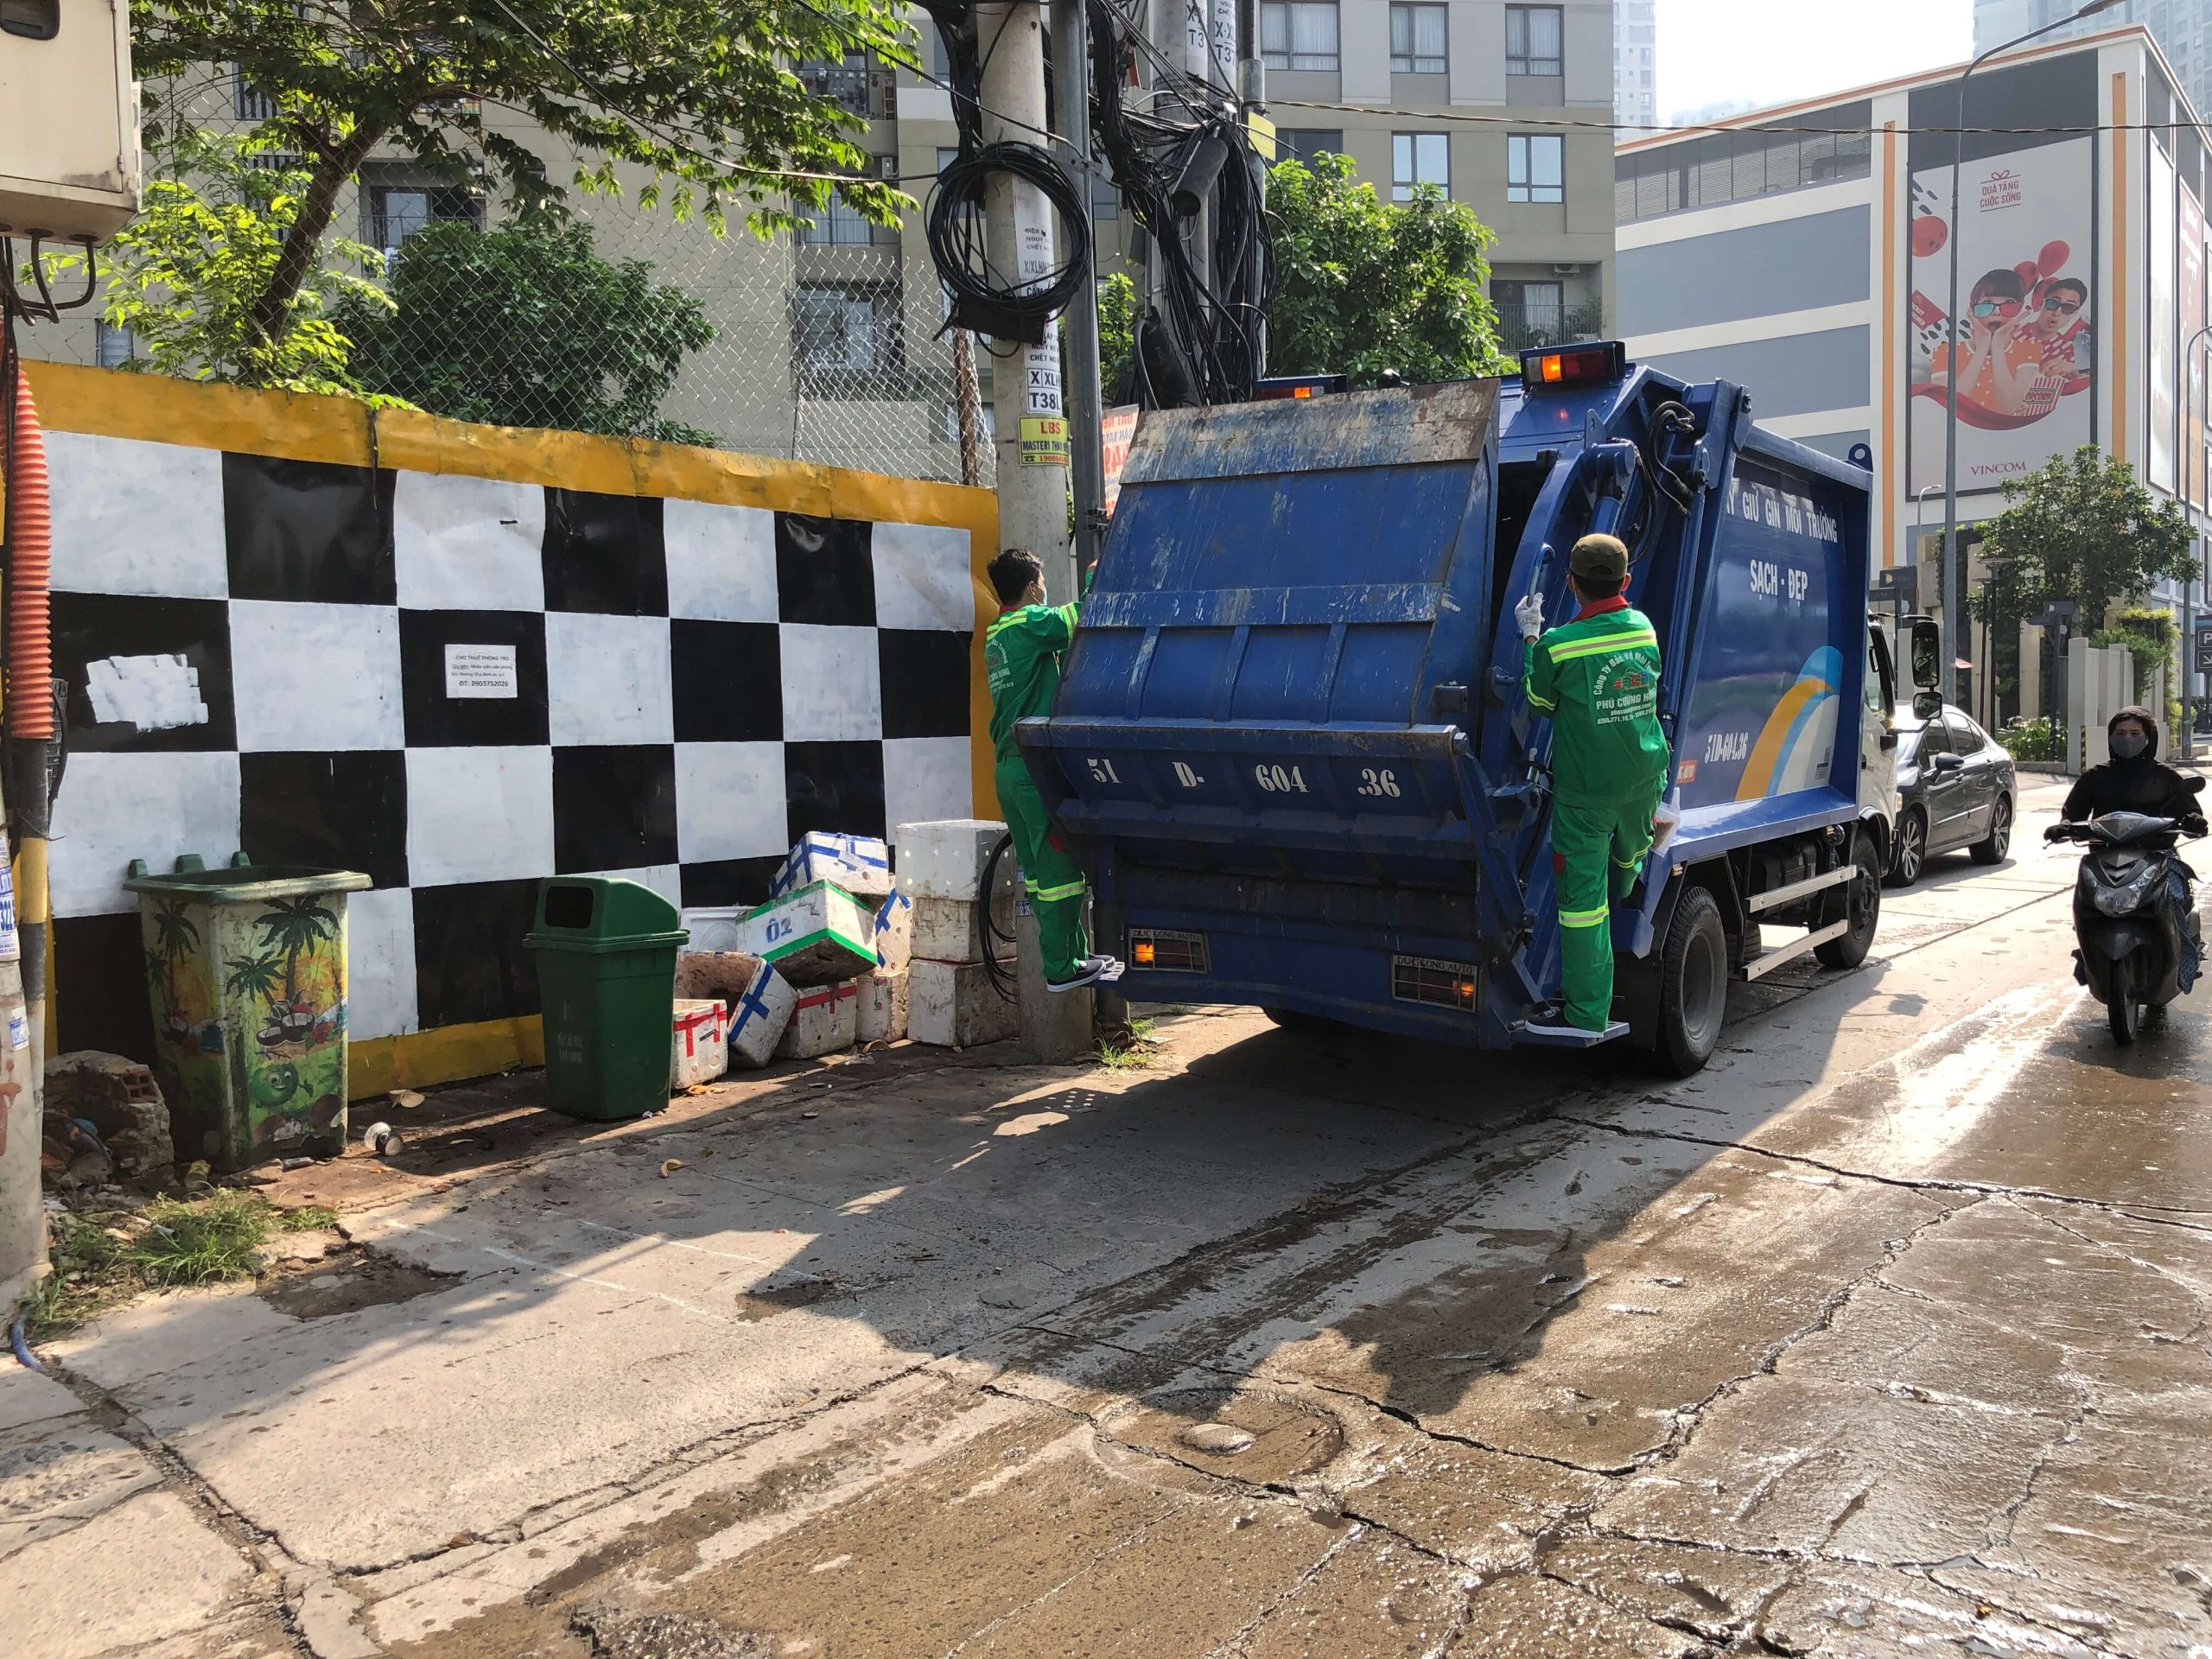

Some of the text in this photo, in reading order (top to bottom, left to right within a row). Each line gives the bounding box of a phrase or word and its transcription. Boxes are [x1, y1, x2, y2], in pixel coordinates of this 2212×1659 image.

[1030, 371, 1040, 385] X
[1040, 421, 1061, 435] LBS
[1022, 440, 1051, 451] MASTERI
[1970, 461, 2026, 476] VINCOM
[1750, 559, 1778, 601] SẠCH
[1788, 568, 1808, 607] ĐẸP
[1596, 697, 1615, 710] PHÚ
[1086, 758, 1122, 785] 51
[1255, 764, 1311, 793] 604
[1153, 931, 1176, 939] LONG
[1397, 956, 1418, 966] DUC
[1420, 959, 1445, 969] LONG
